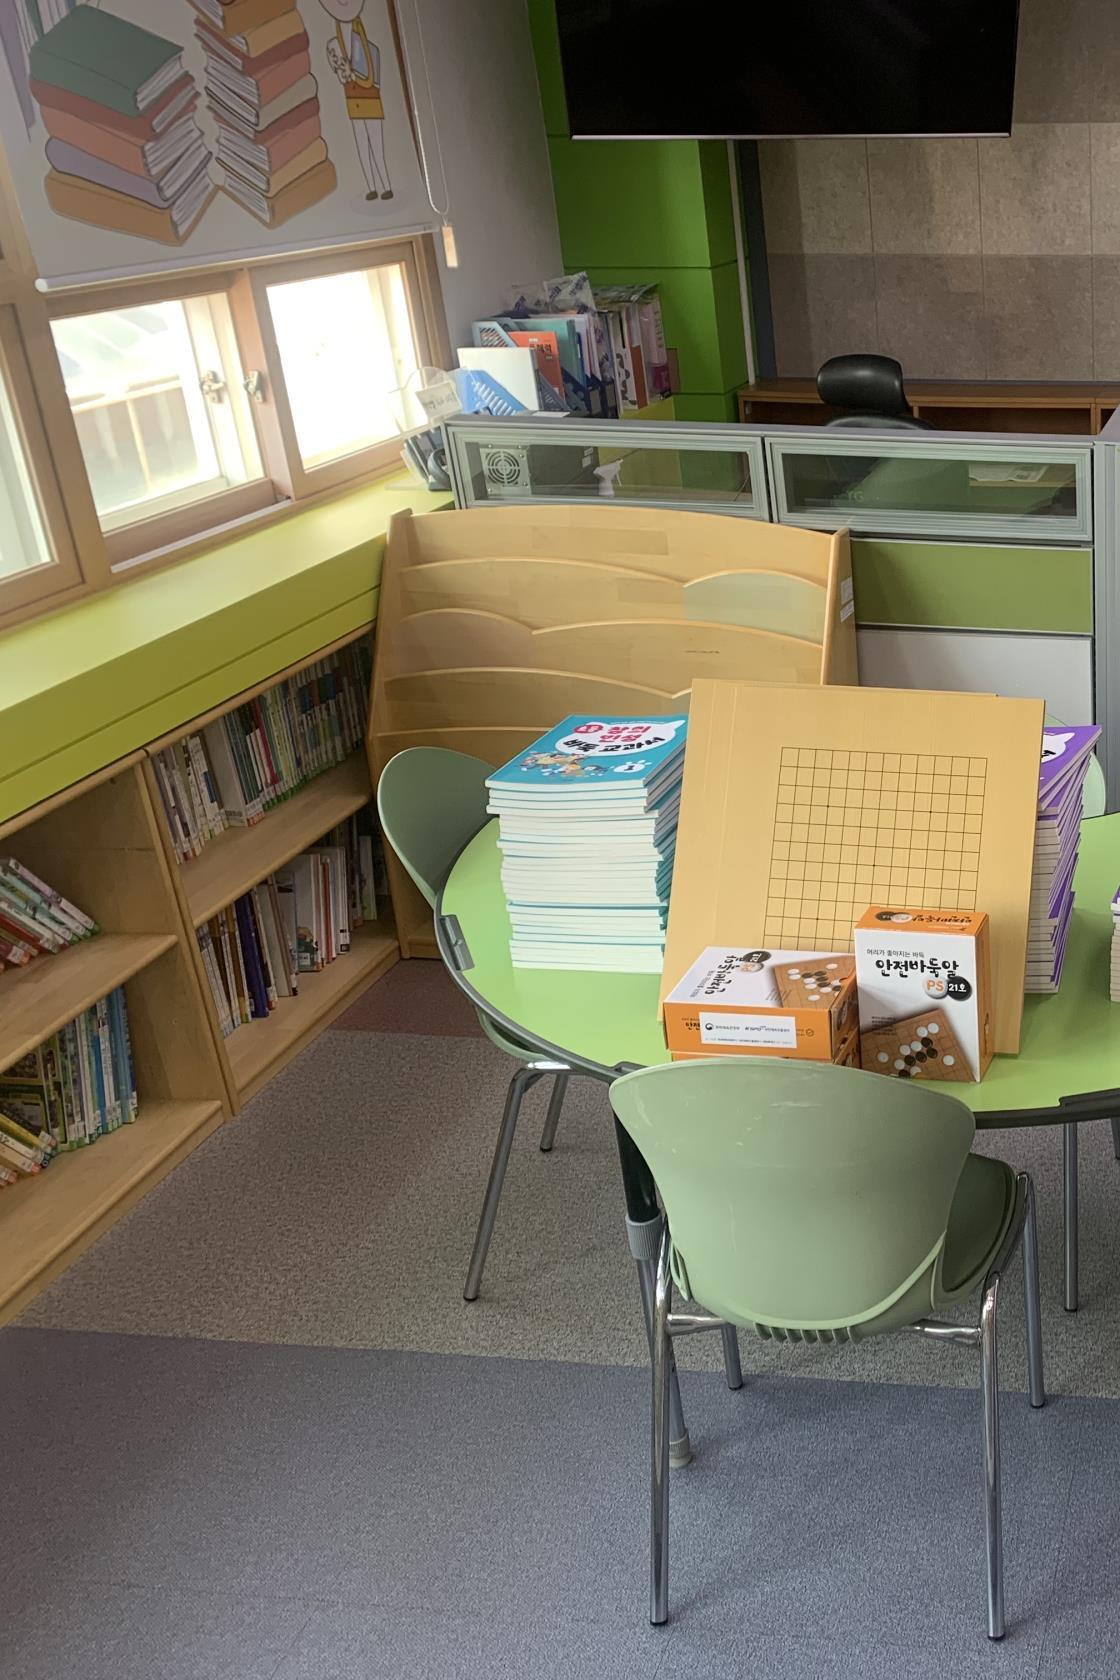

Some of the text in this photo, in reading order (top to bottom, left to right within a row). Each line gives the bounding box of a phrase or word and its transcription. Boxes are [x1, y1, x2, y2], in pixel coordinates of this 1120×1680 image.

[875, 958, 960, 978] 안전바둑알
[927, 979, 967, 993] PS 21호
